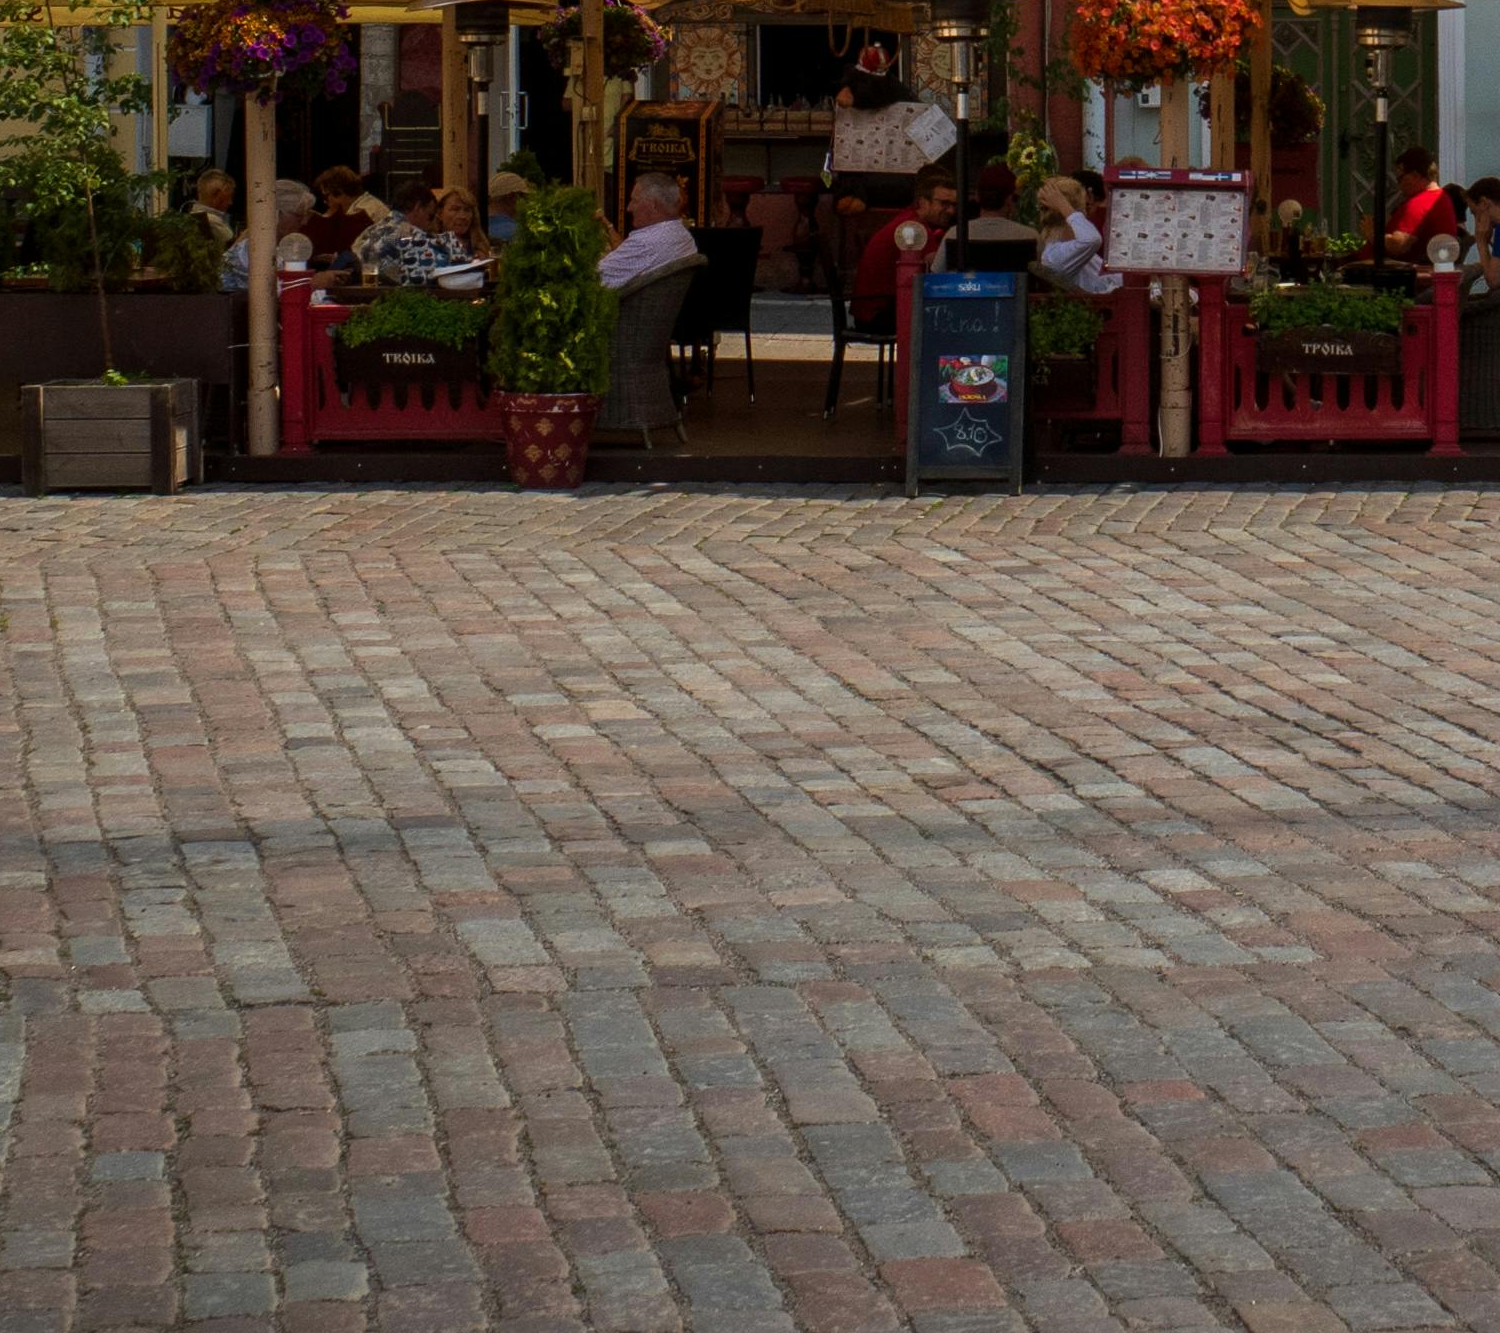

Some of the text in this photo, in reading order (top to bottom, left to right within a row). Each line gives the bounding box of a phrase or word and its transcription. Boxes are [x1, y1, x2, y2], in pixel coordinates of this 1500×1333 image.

[957, 281, 981, 293] saku
[382, 351, 436, 365] TROIKA
[955, 424, 989, 444] 8.10
